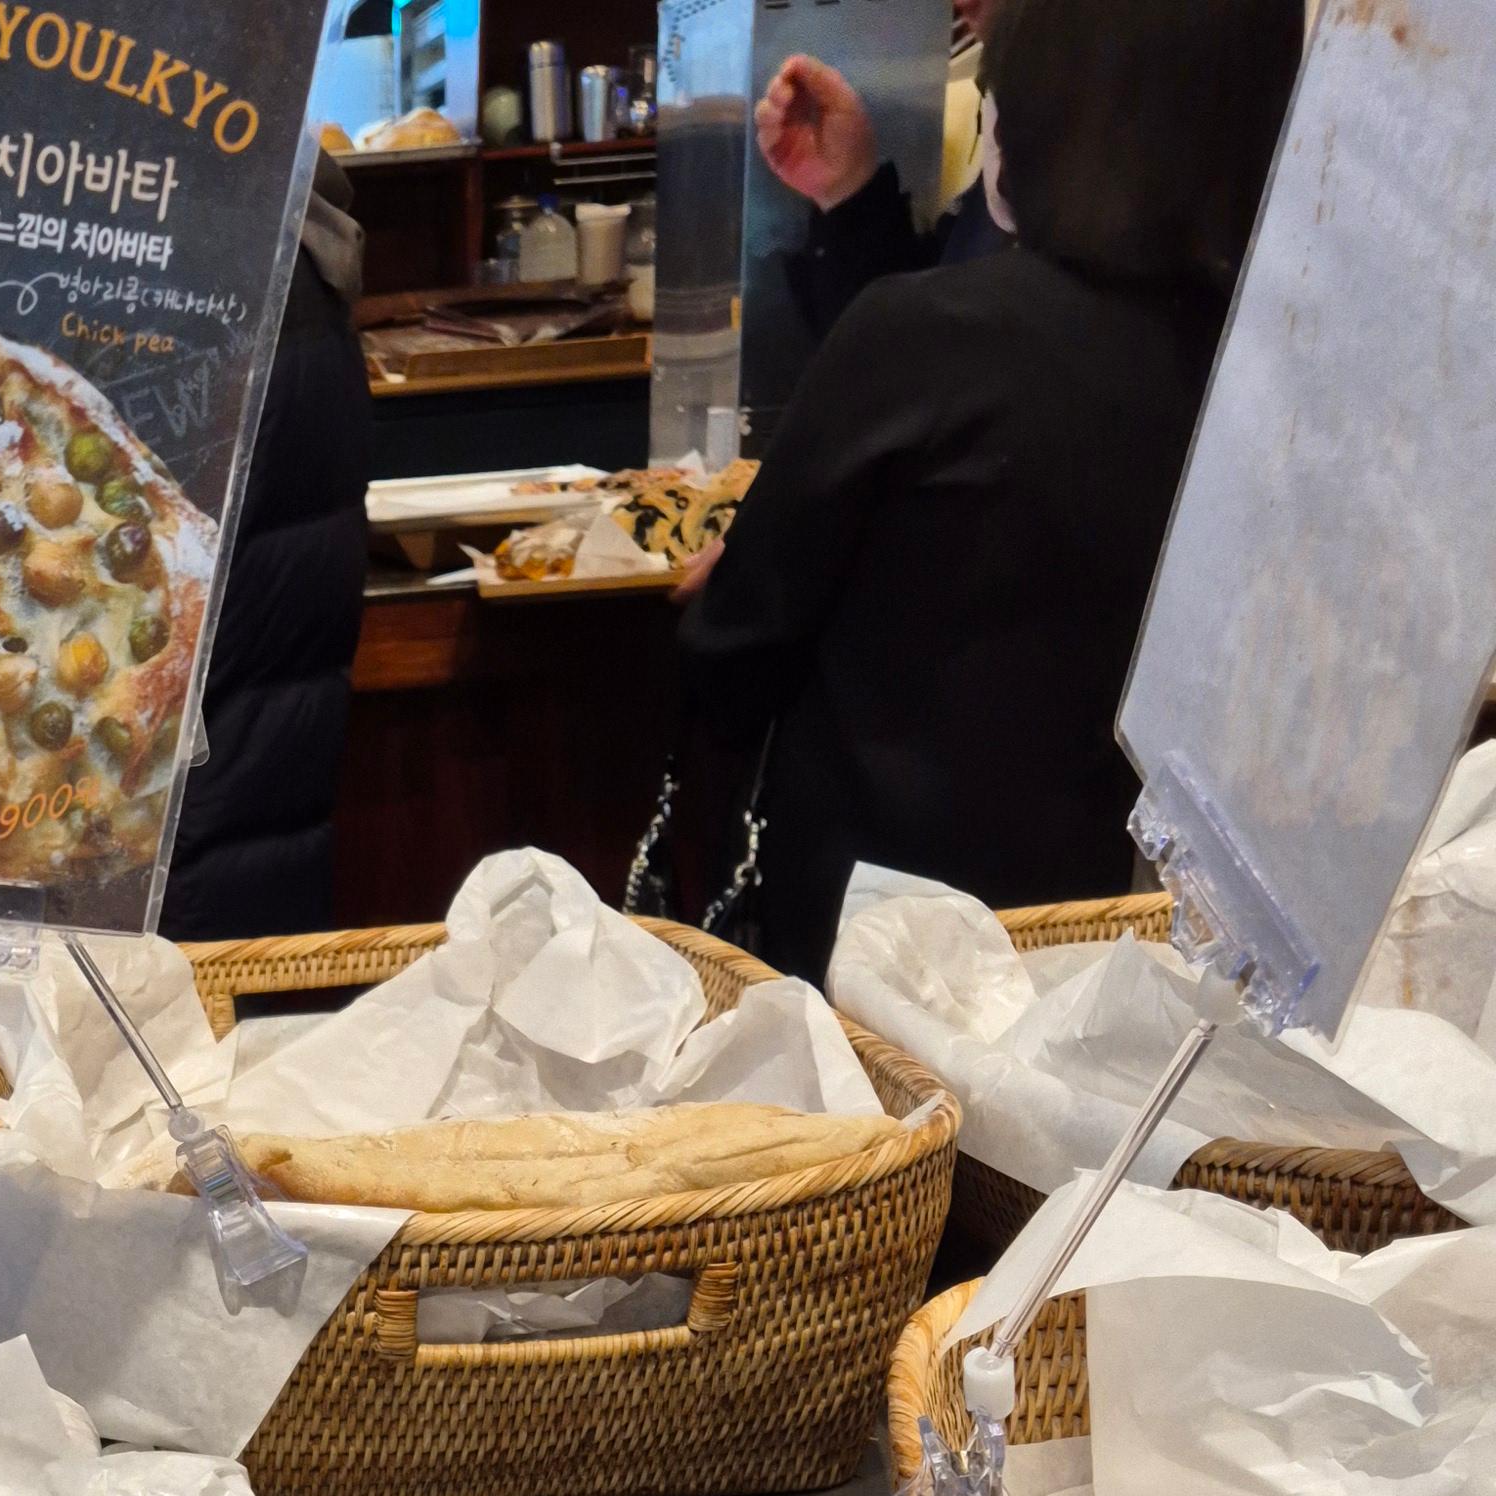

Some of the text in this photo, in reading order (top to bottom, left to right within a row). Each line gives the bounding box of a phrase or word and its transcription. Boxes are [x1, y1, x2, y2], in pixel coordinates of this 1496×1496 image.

[70, 221, 173, 271] 치아바타
[61, 311, 175, 355] Chick pea
